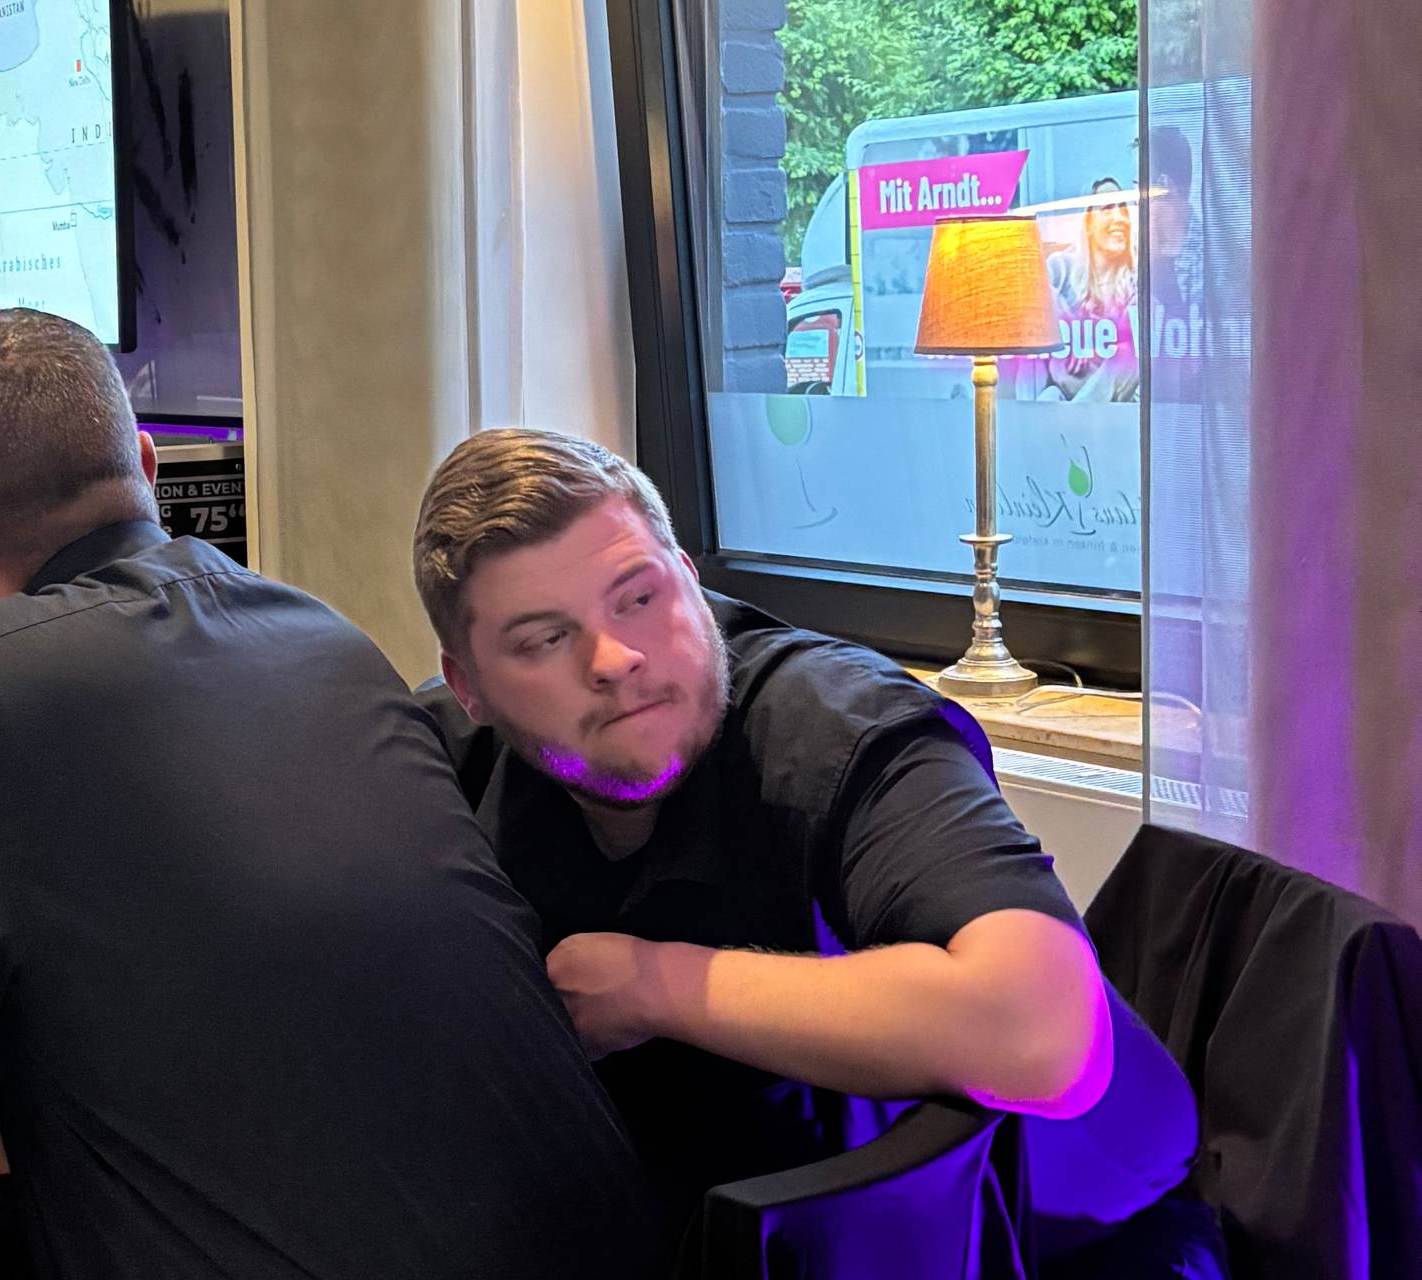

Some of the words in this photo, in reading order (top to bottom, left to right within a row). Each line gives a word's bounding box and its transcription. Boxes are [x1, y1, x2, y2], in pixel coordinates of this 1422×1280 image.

[879, 177, 913, 214] Mit
[917, 172, 1002, 212] Arndt...
[1042, 317, 1118, 359] eue
[155, 484, 183, 499] ION
[187, 484, 198, 496] &
